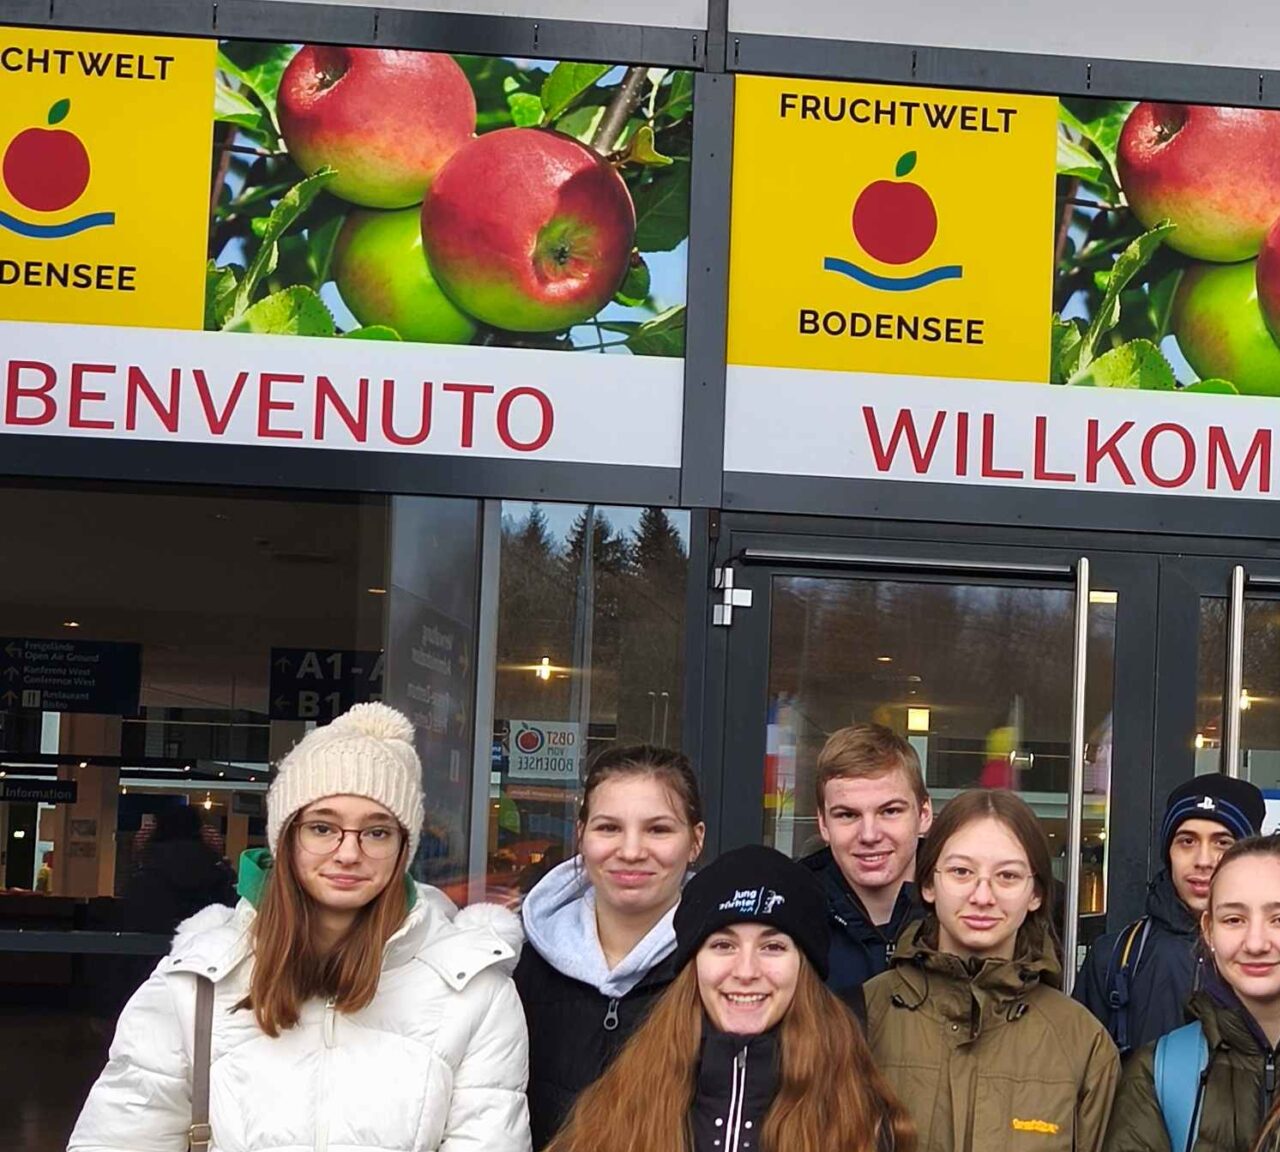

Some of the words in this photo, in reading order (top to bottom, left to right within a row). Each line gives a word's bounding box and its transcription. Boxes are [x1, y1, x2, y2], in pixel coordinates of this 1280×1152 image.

[779, 93, 1018, 133] FRUCHTWELT
[799, 309, 984, 345] BODENSEE
[4, 360, 555, 452] BENVENUTO
[5, 786, 72, 800] Information
